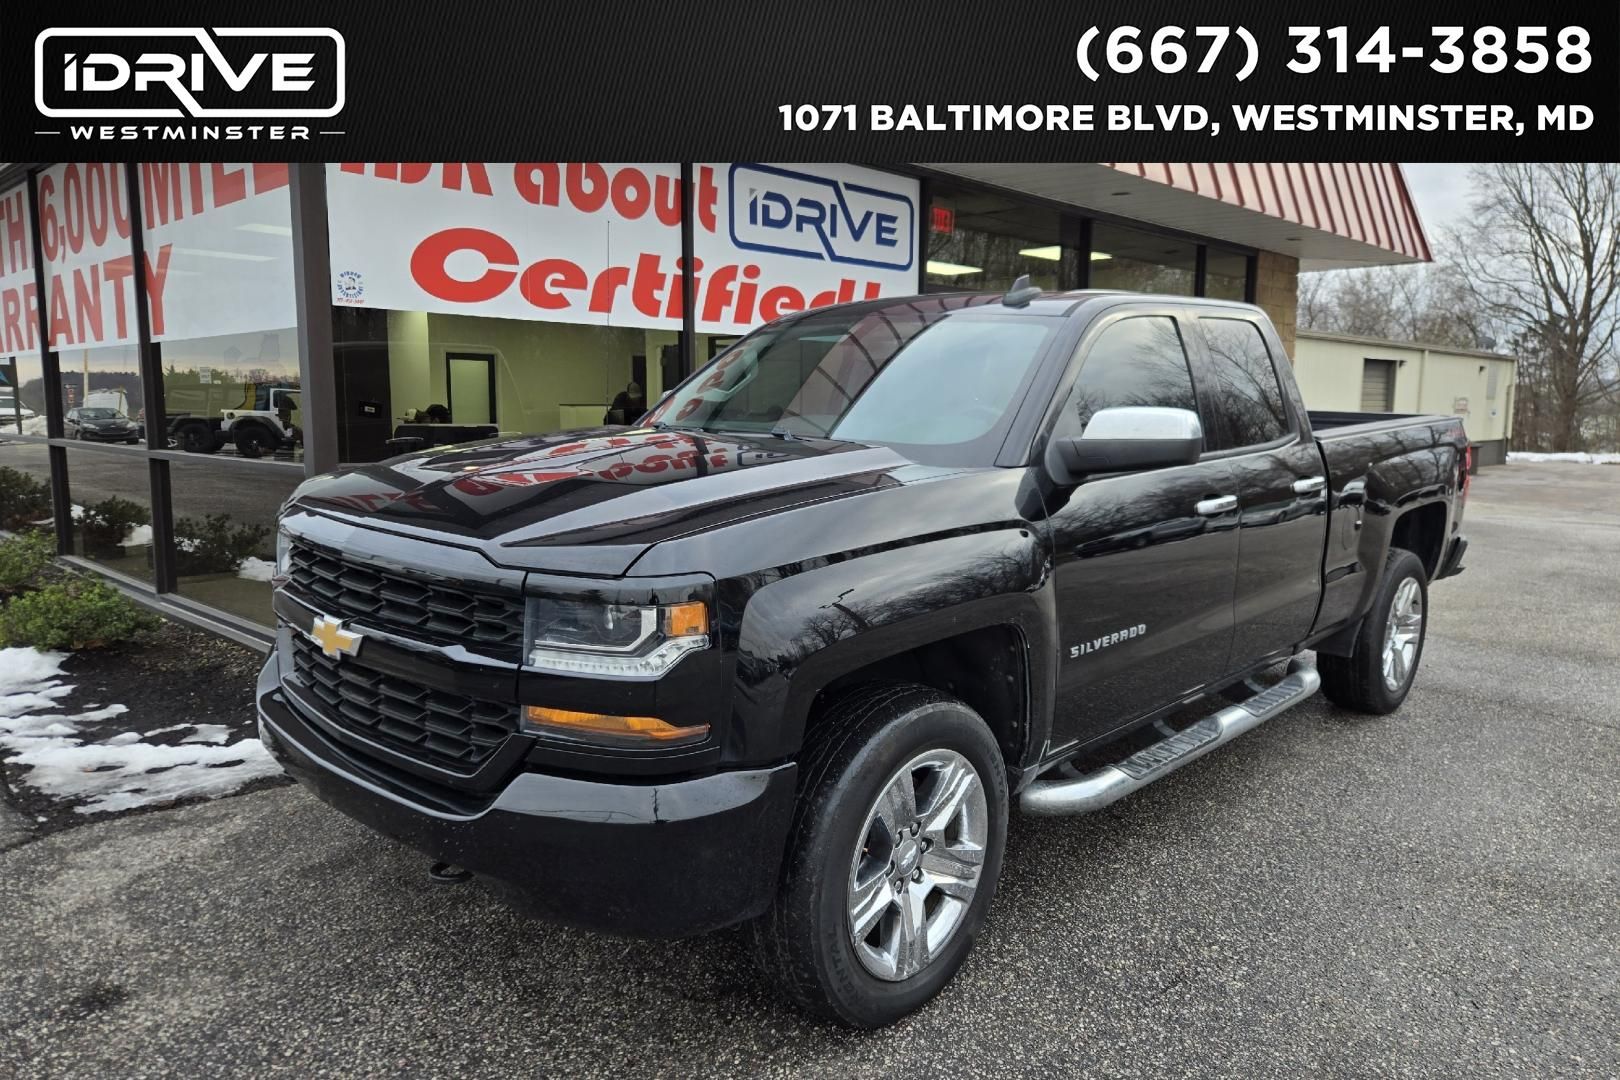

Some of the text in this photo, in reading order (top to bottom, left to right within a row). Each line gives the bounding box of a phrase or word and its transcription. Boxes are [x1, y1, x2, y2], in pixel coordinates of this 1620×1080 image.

[513, 163, 718, 233] about
[0, 243, 173, 353] RRANTY
[410, 227, 881, 326] Certifie
[1070, 623, 1147, 659] SILVERADO
